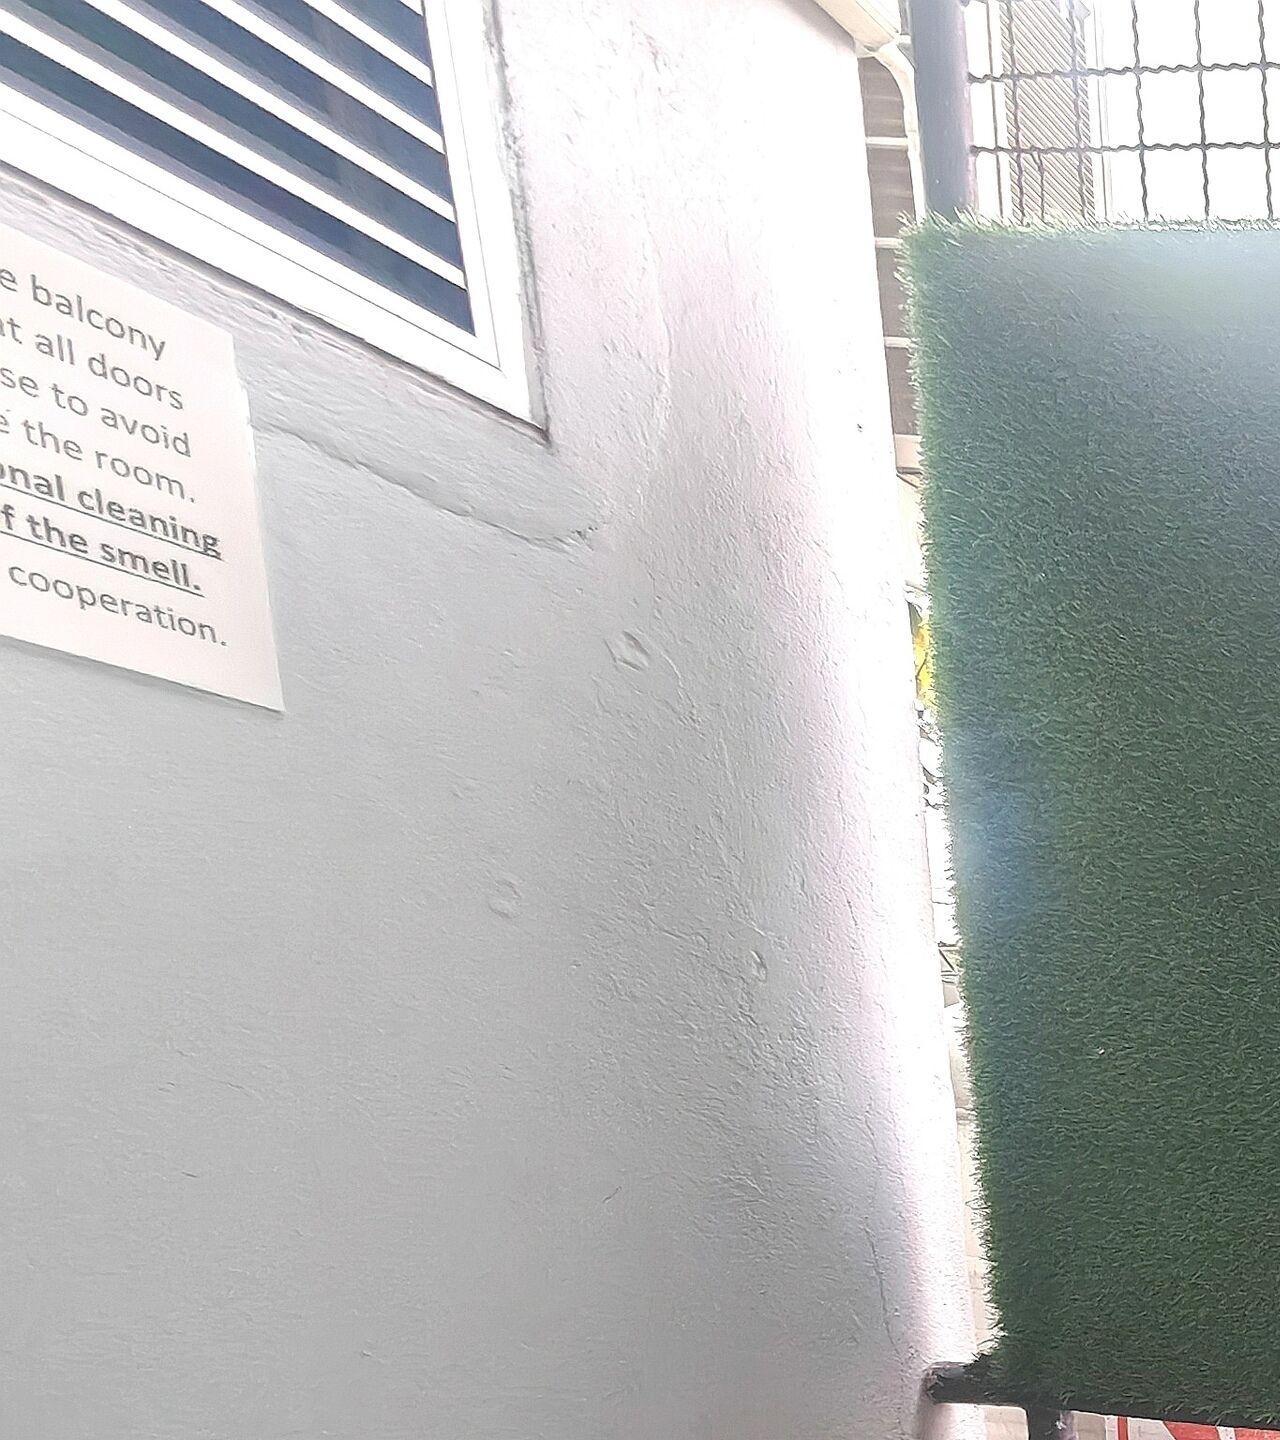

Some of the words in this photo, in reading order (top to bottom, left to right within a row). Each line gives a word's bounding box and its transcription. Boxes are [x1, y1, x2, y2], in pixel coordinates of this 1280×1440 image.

[31, 274, 167, 362] balcony
[35, 333, 76, 366] all
[88, 353, 184, 411] doors
[50, 383, 88, 416] to
[100, 407, 191, 458] avoid
[22, 419, 83, 461] the
[95, 450, 196, 503] room.
[26, 513, 89, 554] the
[100, 543, 202, 591] smell.
[78, 489, 222, 559] cleaning
[8, 564, 227, 646] cooperation.
